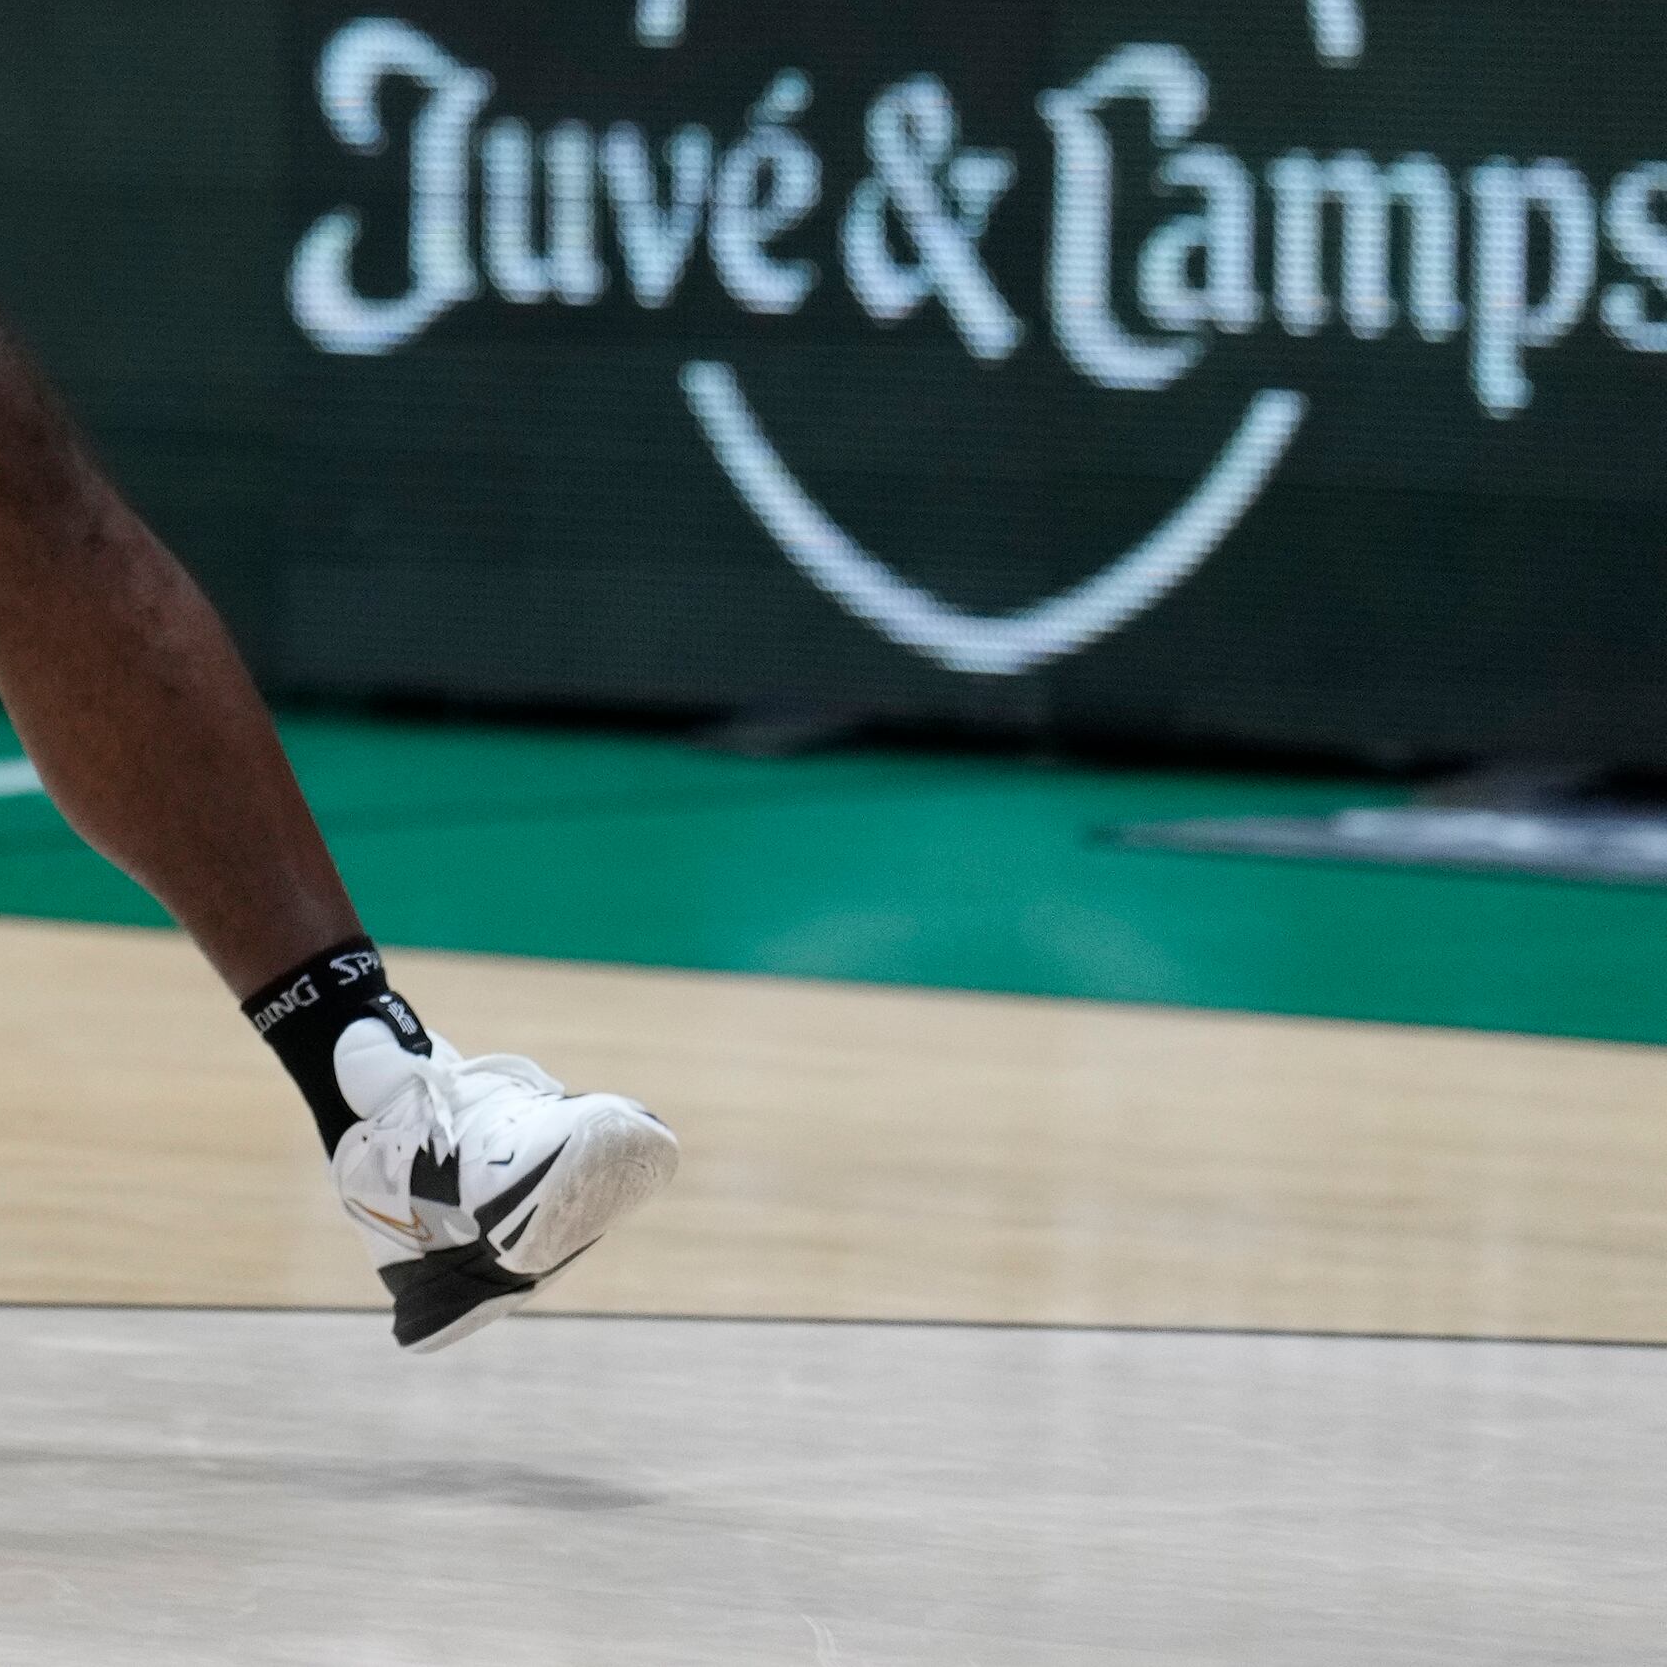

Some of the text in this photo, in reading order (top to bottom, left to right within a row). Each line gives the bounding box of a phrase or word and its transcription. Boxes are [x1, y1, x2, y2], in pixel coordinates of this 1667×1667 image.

[287, 14, 1667, 418] Juvé & Camps
